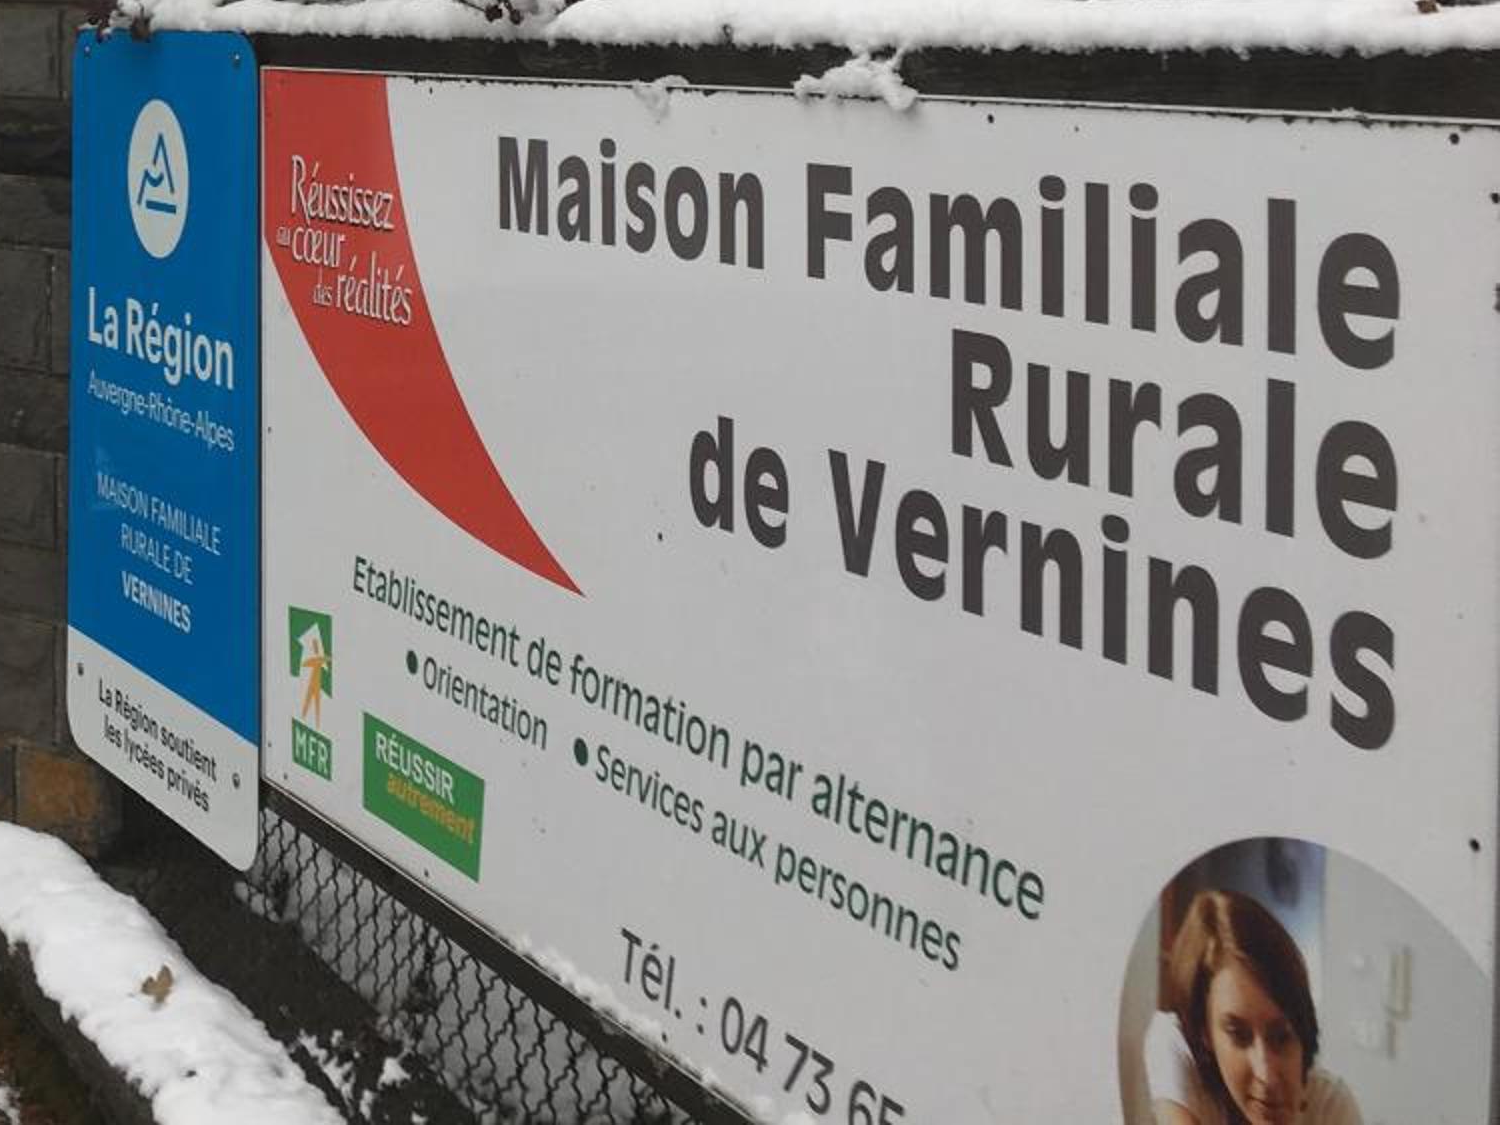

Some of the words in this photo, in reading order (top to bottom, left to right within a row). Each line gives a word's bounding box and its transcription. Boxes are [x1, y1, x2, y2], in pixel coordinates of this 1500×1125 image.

[292, 155, 395, 230] Réussissez
[276, 226, 291, 246] au
[499, 136, 764, 270] Maison
[806, 162, 1400, 370] Familiale
[313, 268, 333, 305] des
[336, 251, 412, 324] réalités
[88, 286, 119, 350] La
[126, 296, 235, 390] Région
[87, 369, 235, 452] Auvergne-Rhône-Alpes
[951, 328, 1398, 560] Rurale
[97, 471, 148, 519] MAISON
[151, 496, 221, 556] FAMILIALE
[120, 522, 172, 574] RURALE
[173, 552, 194, 585] DE
[121, 571, 192, 634] VERNINES
[689, 415, 789, 549] de
[827, 448, 1395, 751] Vernines
[99, 677, 111, 707] La
[115, 690, 158, 741] Région
[161, 726, 216, 781] soutient
[104, 715, 121, 749] les
[124, 727, 164, 780] lycées
[168, 765, 209, 812] privés
[295, 727, 328, 773] MFR
[353, 555, 521, 668] Etablissement
[527, 637, 563, 686] de
[569, 653, 730, 769] formation
[740, 739, 805, 801] par
[811, 773, 1045, 922] alternance
[375, 731, 455, 804] RÉUSSIR
[387, 774, 475, 844] autrement
[423, 656, 547, 750] Orientation
[595, 744, 704, 834] Services
[711, 810, 767, 868] aux
[774, 843, 961, 972] personnes
[621, 927, 682, 1020] Tél.
[720, 995, 769, 1074] 04
[783, 1031, 835, 1116] 73
